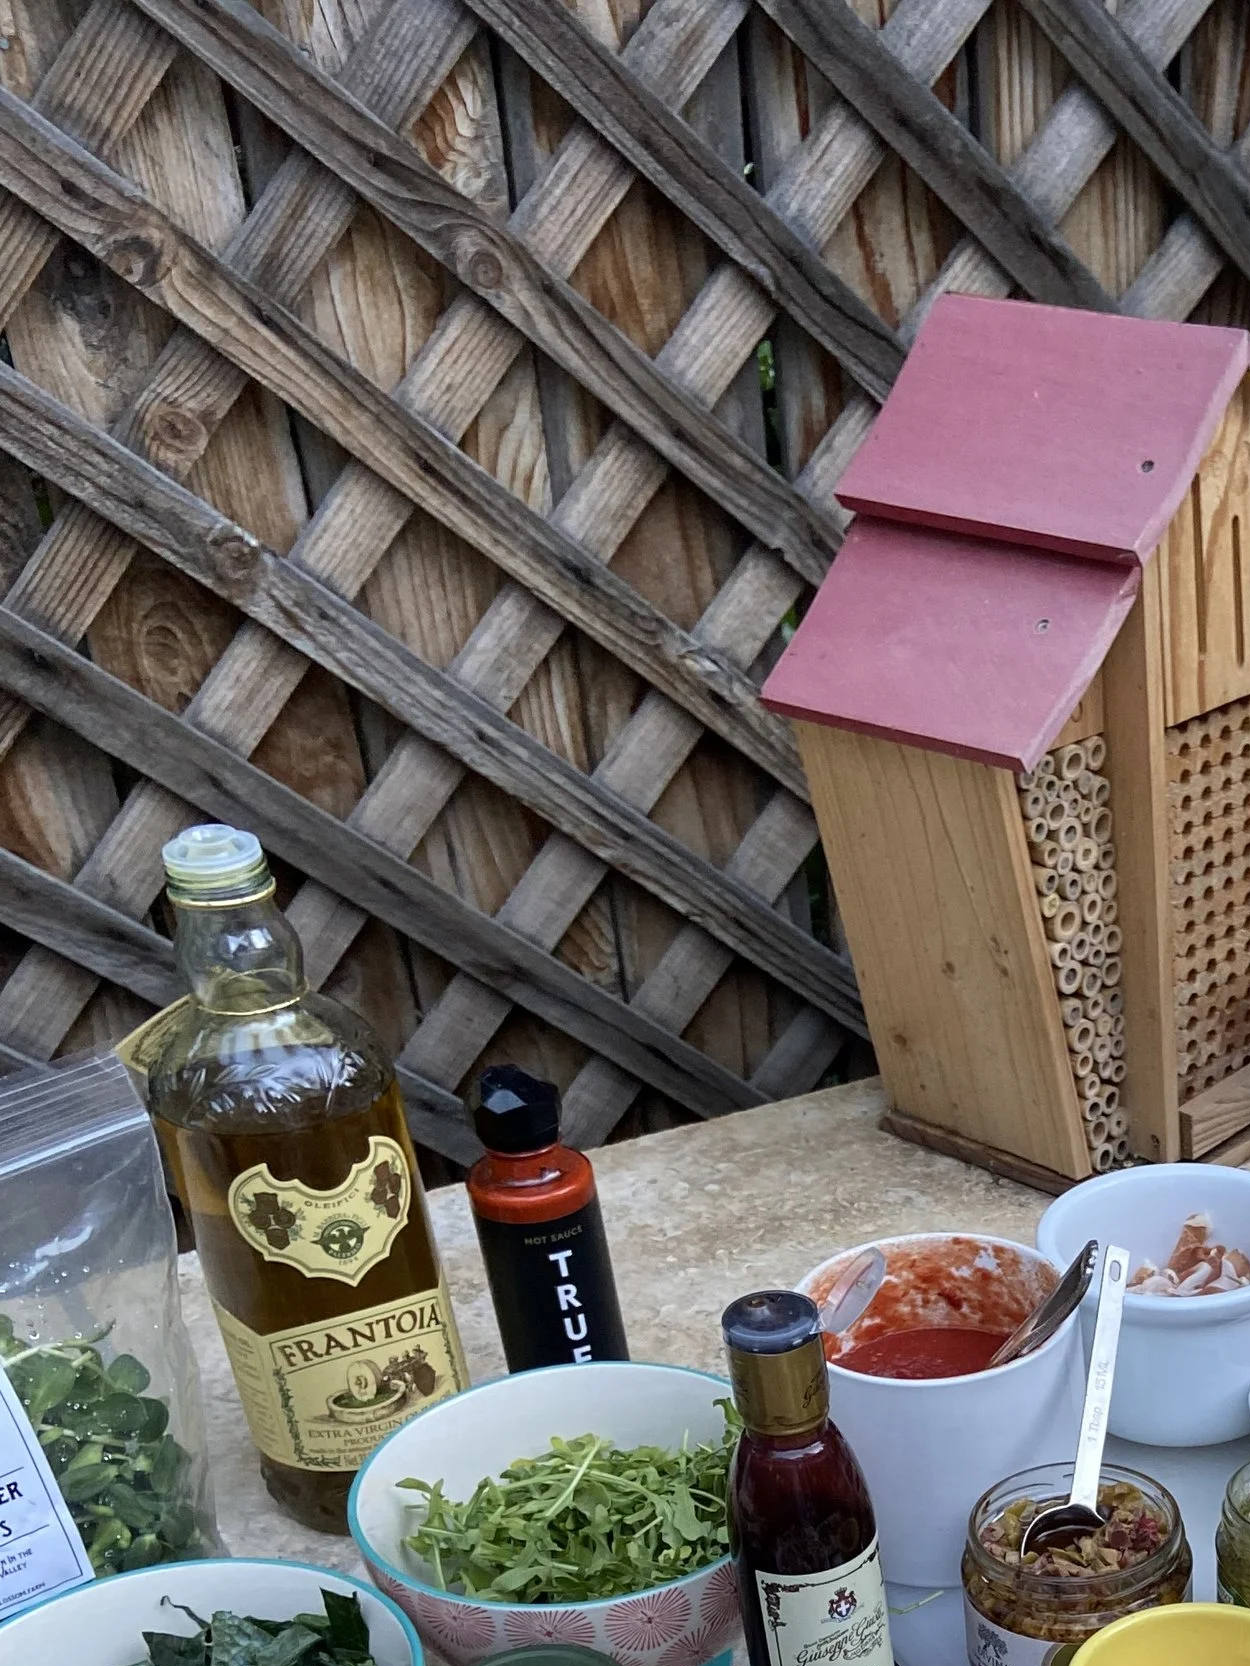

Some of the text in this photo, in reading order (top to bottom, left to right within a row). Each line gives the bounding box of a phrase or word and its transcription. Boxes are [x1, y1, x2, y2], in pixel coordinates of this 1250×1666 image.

[524, 1225, 583, 1245] HOT SAUCE
[279, 1304, 442, 1367] FRANTOIA
[308, 1429, 352, 1439] EXTRA
[19, 1548, 33, 1560] THE
